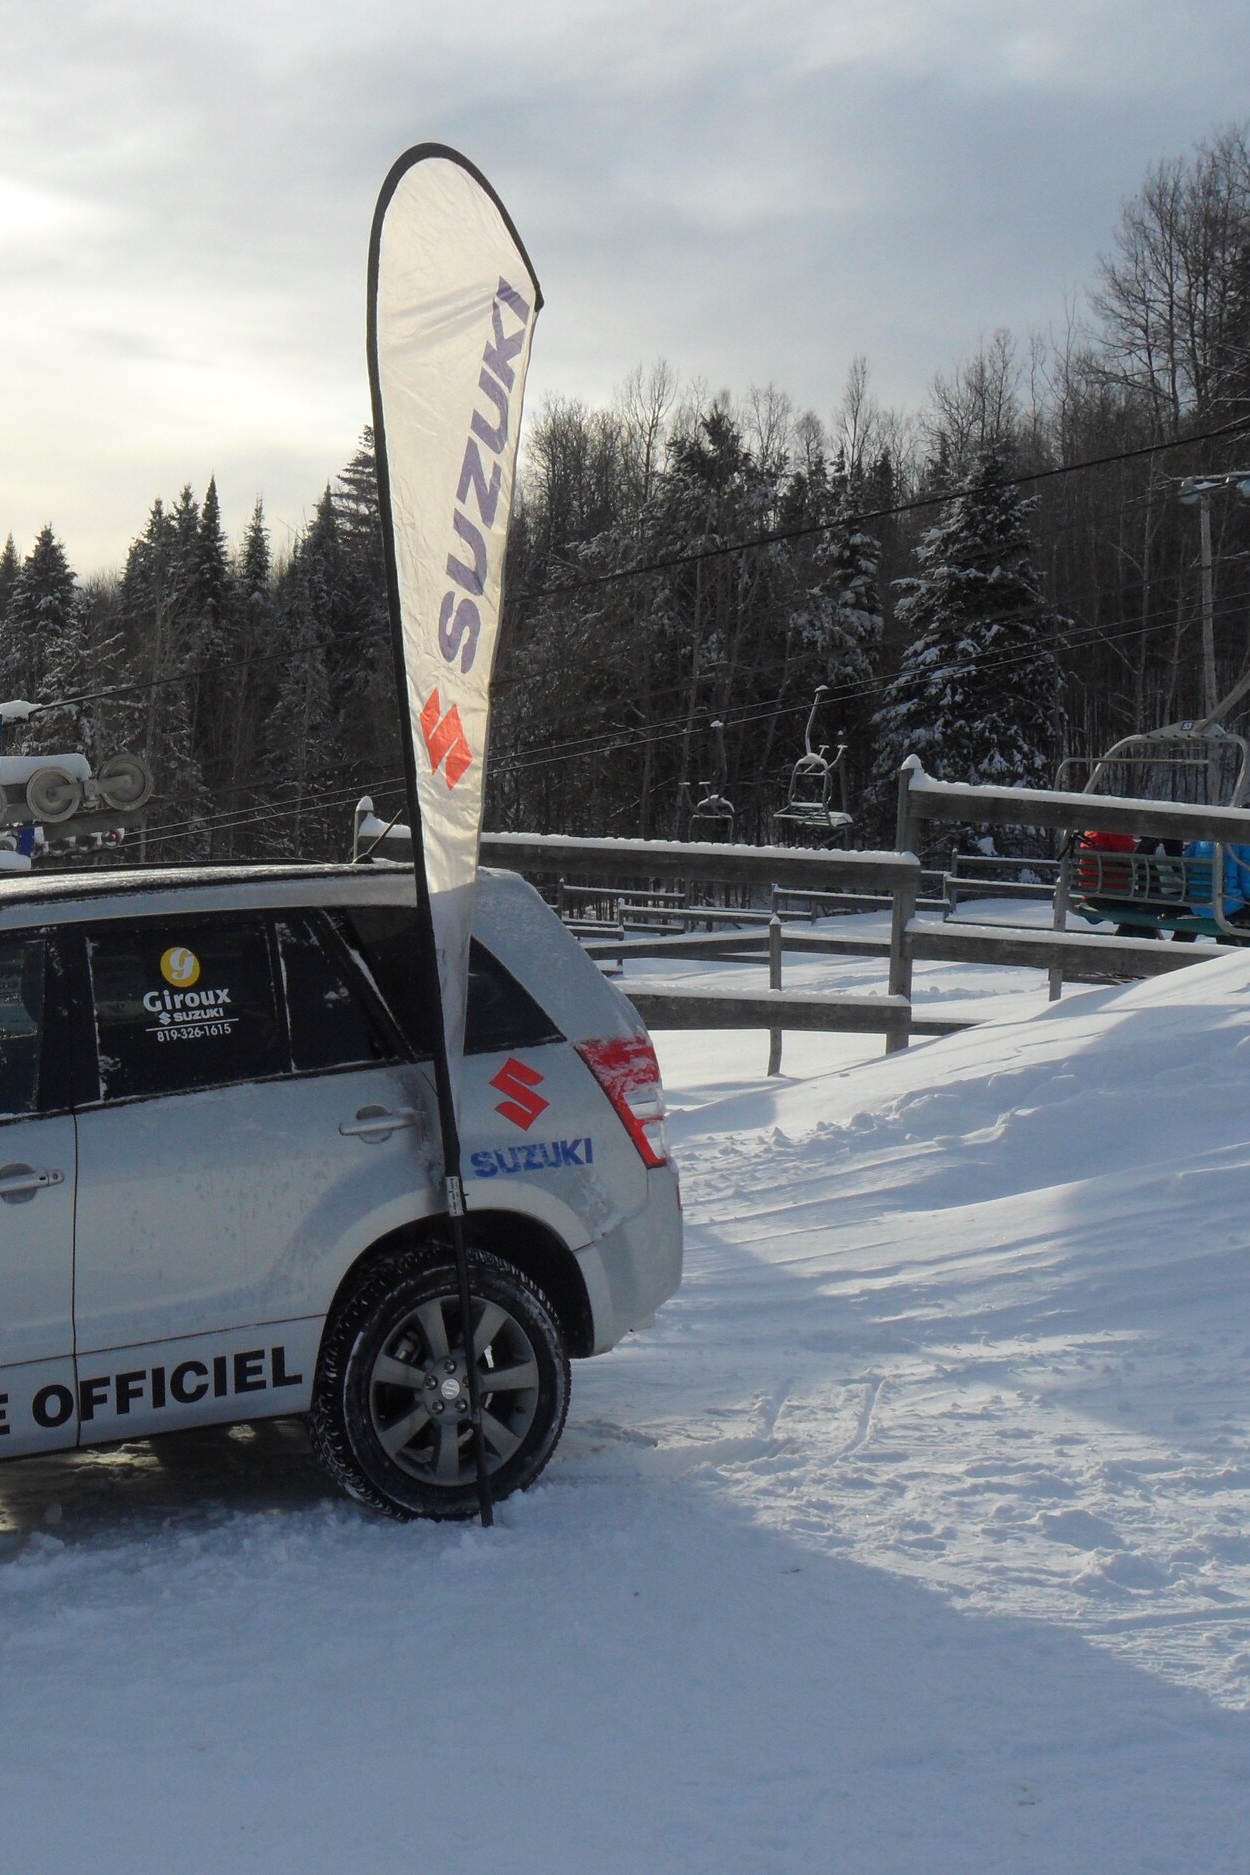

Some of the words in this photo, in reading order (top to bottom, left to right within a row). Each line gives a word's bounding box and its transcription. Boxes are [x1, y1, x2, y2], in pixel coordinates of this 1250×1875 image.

[438, 275, 531, 674] SUZUKI
[142, 987, 233, 1012] Giroux
[173, 1007, 225, 1023] SUZUKI
[156, 1023, 232, 1043] 819-326-1615
[470, 1137, 594, 1179] SUZUKI
[31, 1345, 303, 1429] OFFICIEL
